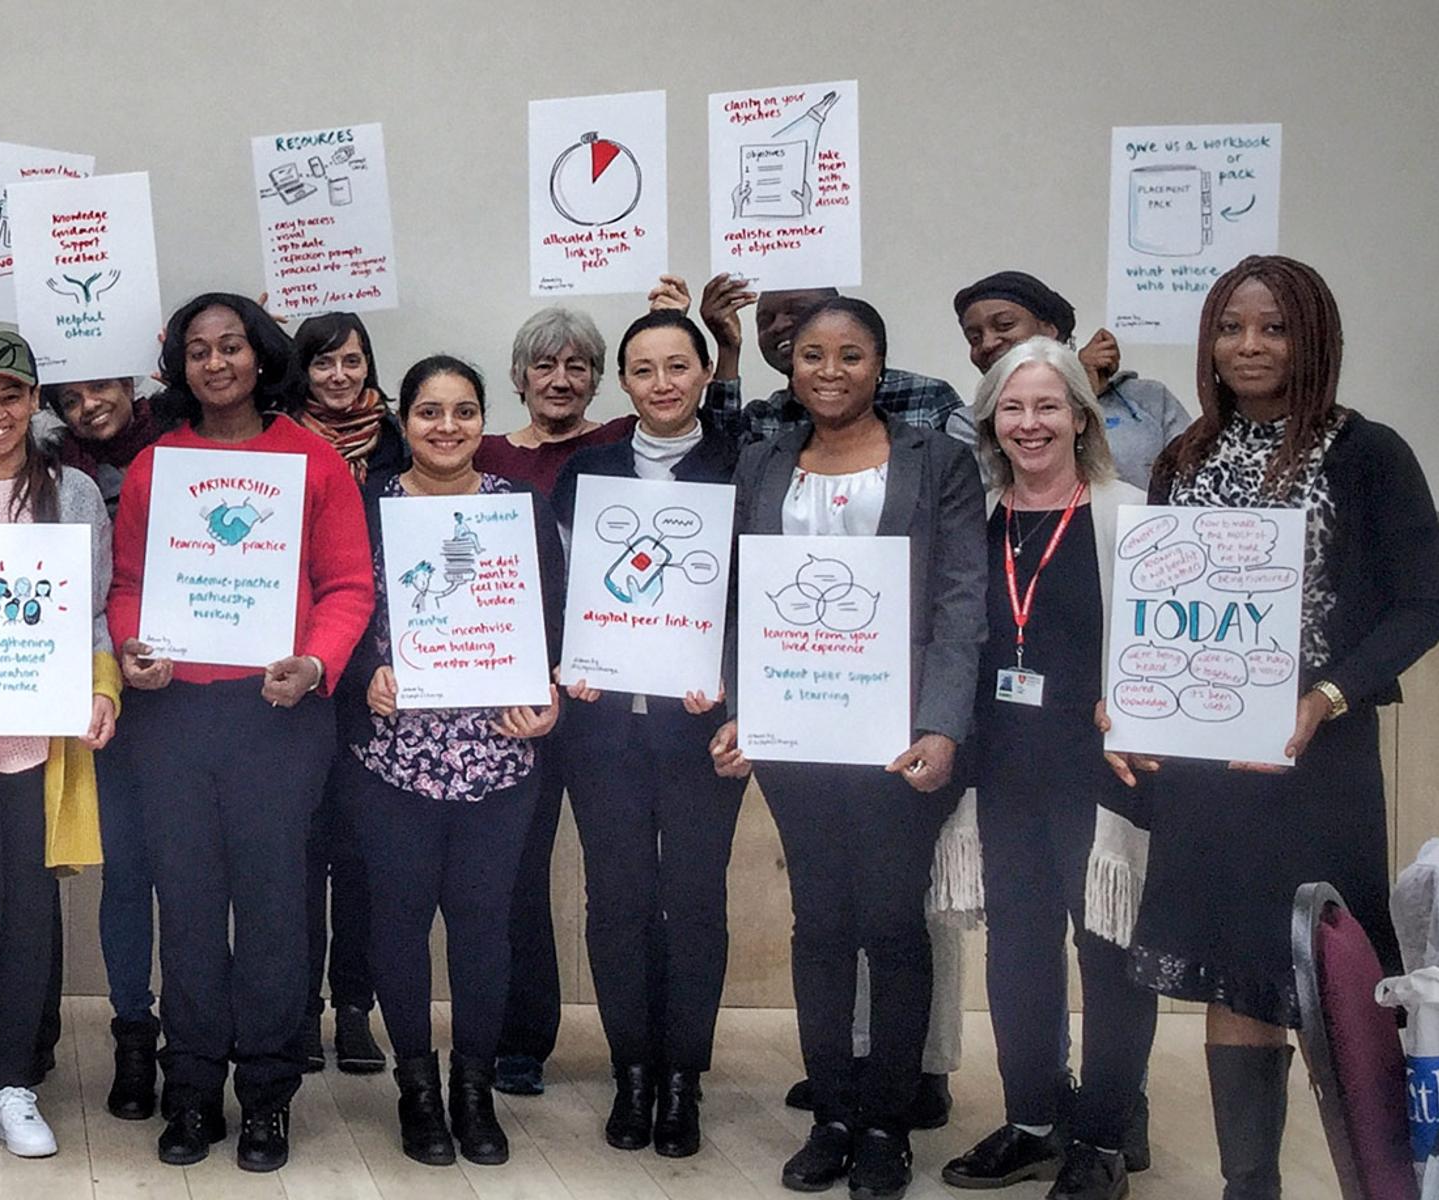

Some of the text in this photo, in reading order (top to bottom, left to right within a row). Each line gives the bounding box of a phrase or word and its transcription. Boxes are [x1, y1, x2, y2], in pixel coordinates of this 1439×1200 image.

[725, 92, 805, 113] clarity on your
[730, 110, 781, 125] objectives
[276, 129, 354, 151] RESOURCES
[746, 150, 785, 161] objectives
[819, 151, 840, 159] take
[1126, 137, 1270, 160] give us a workbook
[1227, 154, 1243, 163] or
[818, 162, 846, 170] them
[818, 174, 841, 182] with
[1219, 168, 1255, 185] pack
[819, 185, 838, 194] you
[1138, 185, 1191, 193] PLACEMENT
[816, 197, 849, 206] discuss
[52, 211, 108, 225] Knowledge
[275, 216, 335, 230] easy to access
[52, 225, 108, 238] Guidance
[277, 230, 305, 240] visual
[543, 226, 645, 245] allocated time to
[725, 226, 825, 241] realistic number
[60, 239, 101, 250] Support
[278, 238, 323, 253] up to date
[731, 241, 801, 256] of objectives
[55, 252, 109, 265] Feedback
[280, 247, 363, 263] reflection prompts
[565, 245, 631, 261] link up with
[280, 264, 320, 278] practical
[323, 263, 341, 272] info
[582, 259, 608, 271] peers
[1127, 266, 1219, 276] what where
[282, 283, 318, 295] quizzes
[1137, 280, 1164, 290] who
[285, 299, 298, 308] top
[302, 295, 319, 306] tips
[56, 312, 105, 326] Helpful
[65, 327, 102, 338] others
[189, 477, 280, 498] PARTNERSHIP
[169, 537, 216, 555] learning
[242, 540, 286, 555] practice
[480, 559, 494, 567] we
[479, 569, 518, 580] want to
[470, 581, 526, 595] feel like a
[189, 591, 256, 608] partnership
[477, 596, 515, 607] burden
[194, 609, 240, 626] working
[408, 615, 449, 627] mentor
[584, 611, 628, 627] digital
[632, 616, 659, 628] peer
[1126, 598, 1274, 645] TODAY
[451, 622, 515, 635] incentivise
[763, 628, 879, 644] learning from your
[415, 642, 495, 656] team building
[782, 642, 865, 654] lived experience
[433, 655, 516, 670] mentor support
[764, 666, 891, 685] Student peer support
[784, 690, 849, 707] & learning
[1121, 695, 1169, 711] knowledge
